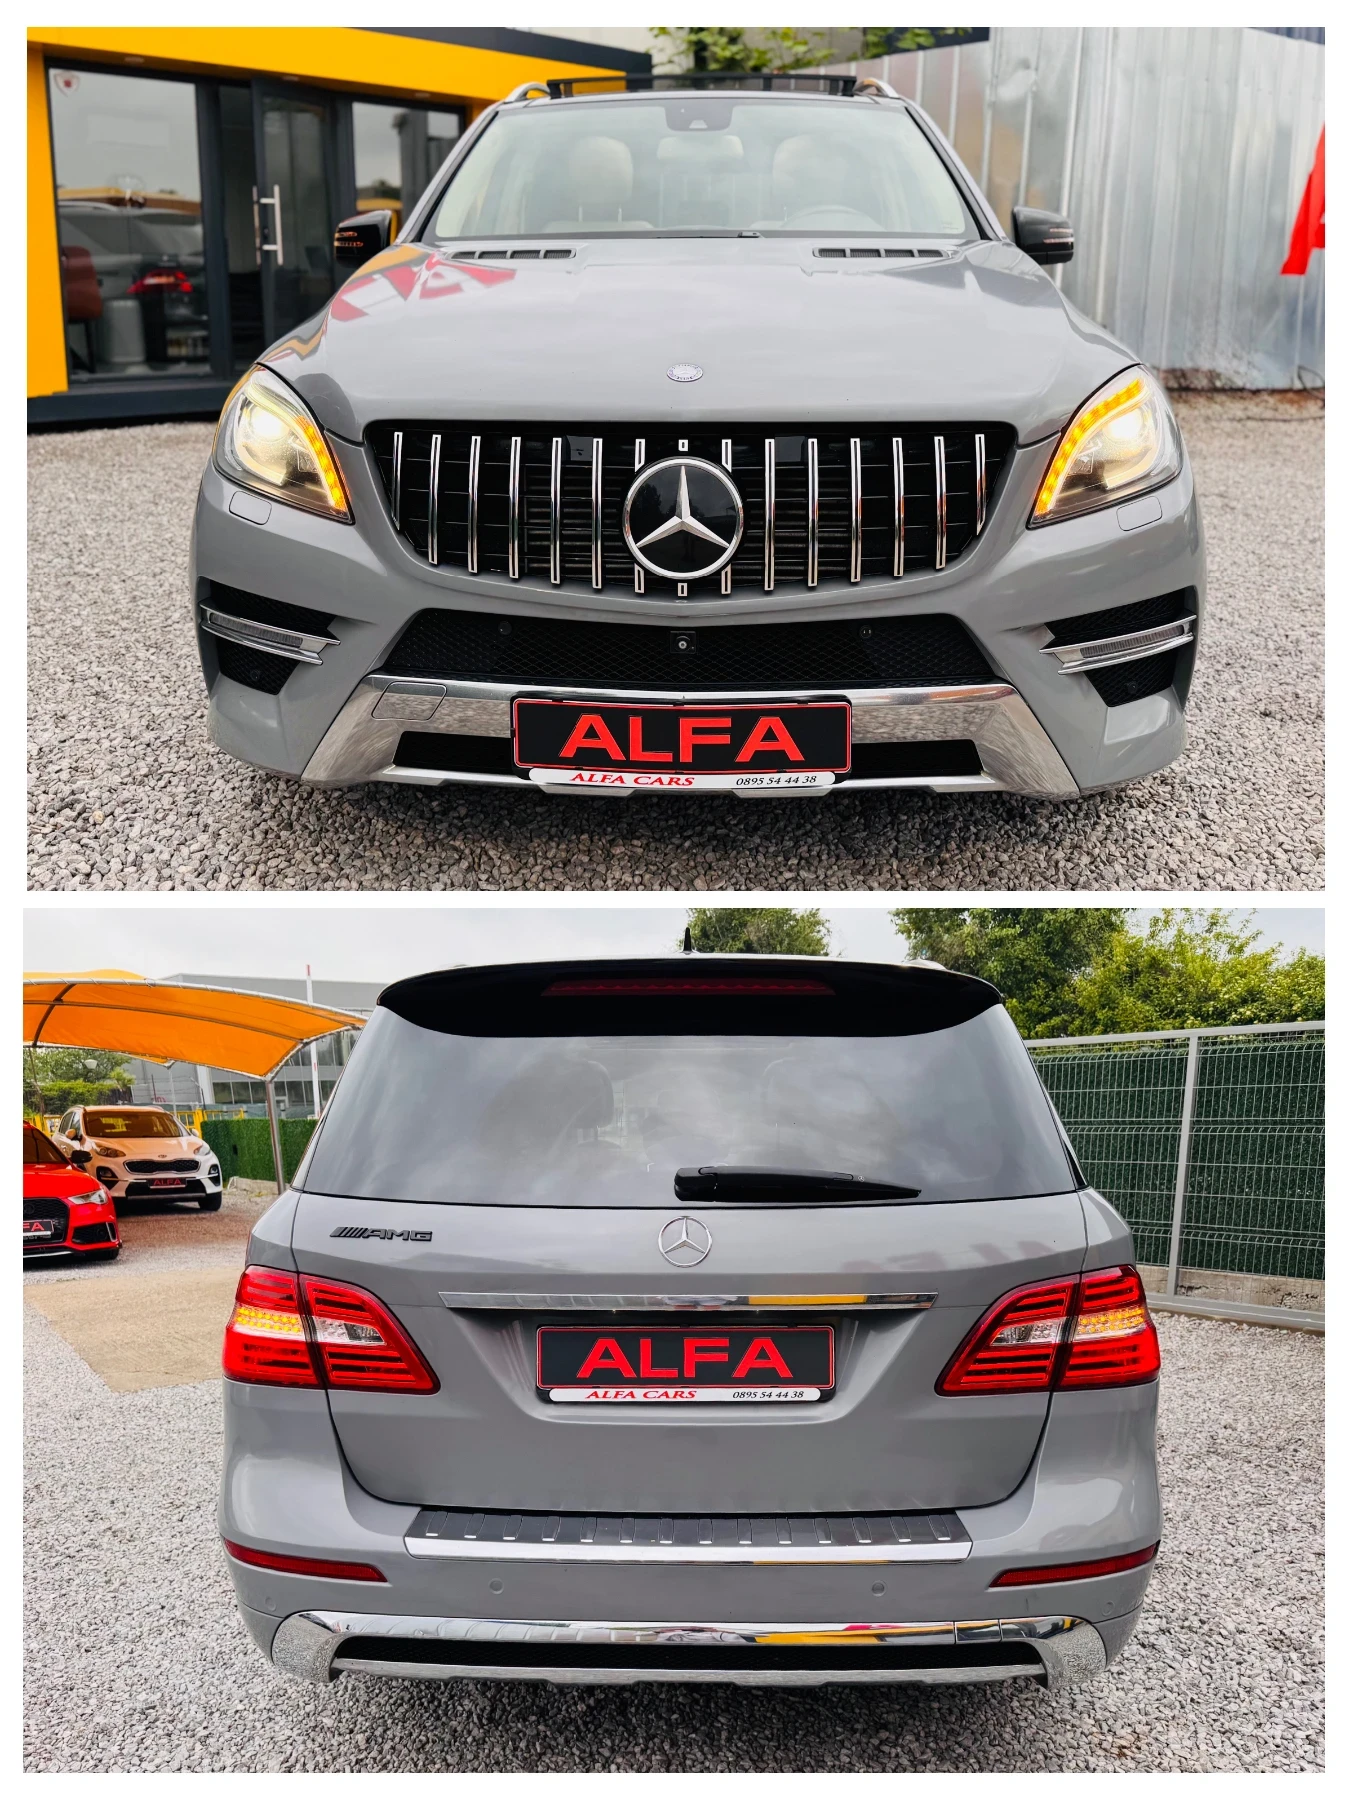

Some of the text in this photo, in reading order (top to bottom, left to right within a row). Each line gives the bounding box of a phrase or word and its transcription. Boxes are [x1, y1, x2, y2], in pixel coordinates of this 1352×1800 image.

[559, 713, 805, 763] ALFA
[569, 772, 695, 786] ALFA CARS
[735, 775, 817, 786] 0895 54 44 38
[362, 1228, 433, 1242] AMG
[576, 1336, 794, 1378] ALFA
[585, 1390, 697, 1399] ALFA CARS
[732, 1390, 805, 1399] 0895 54 44 38
